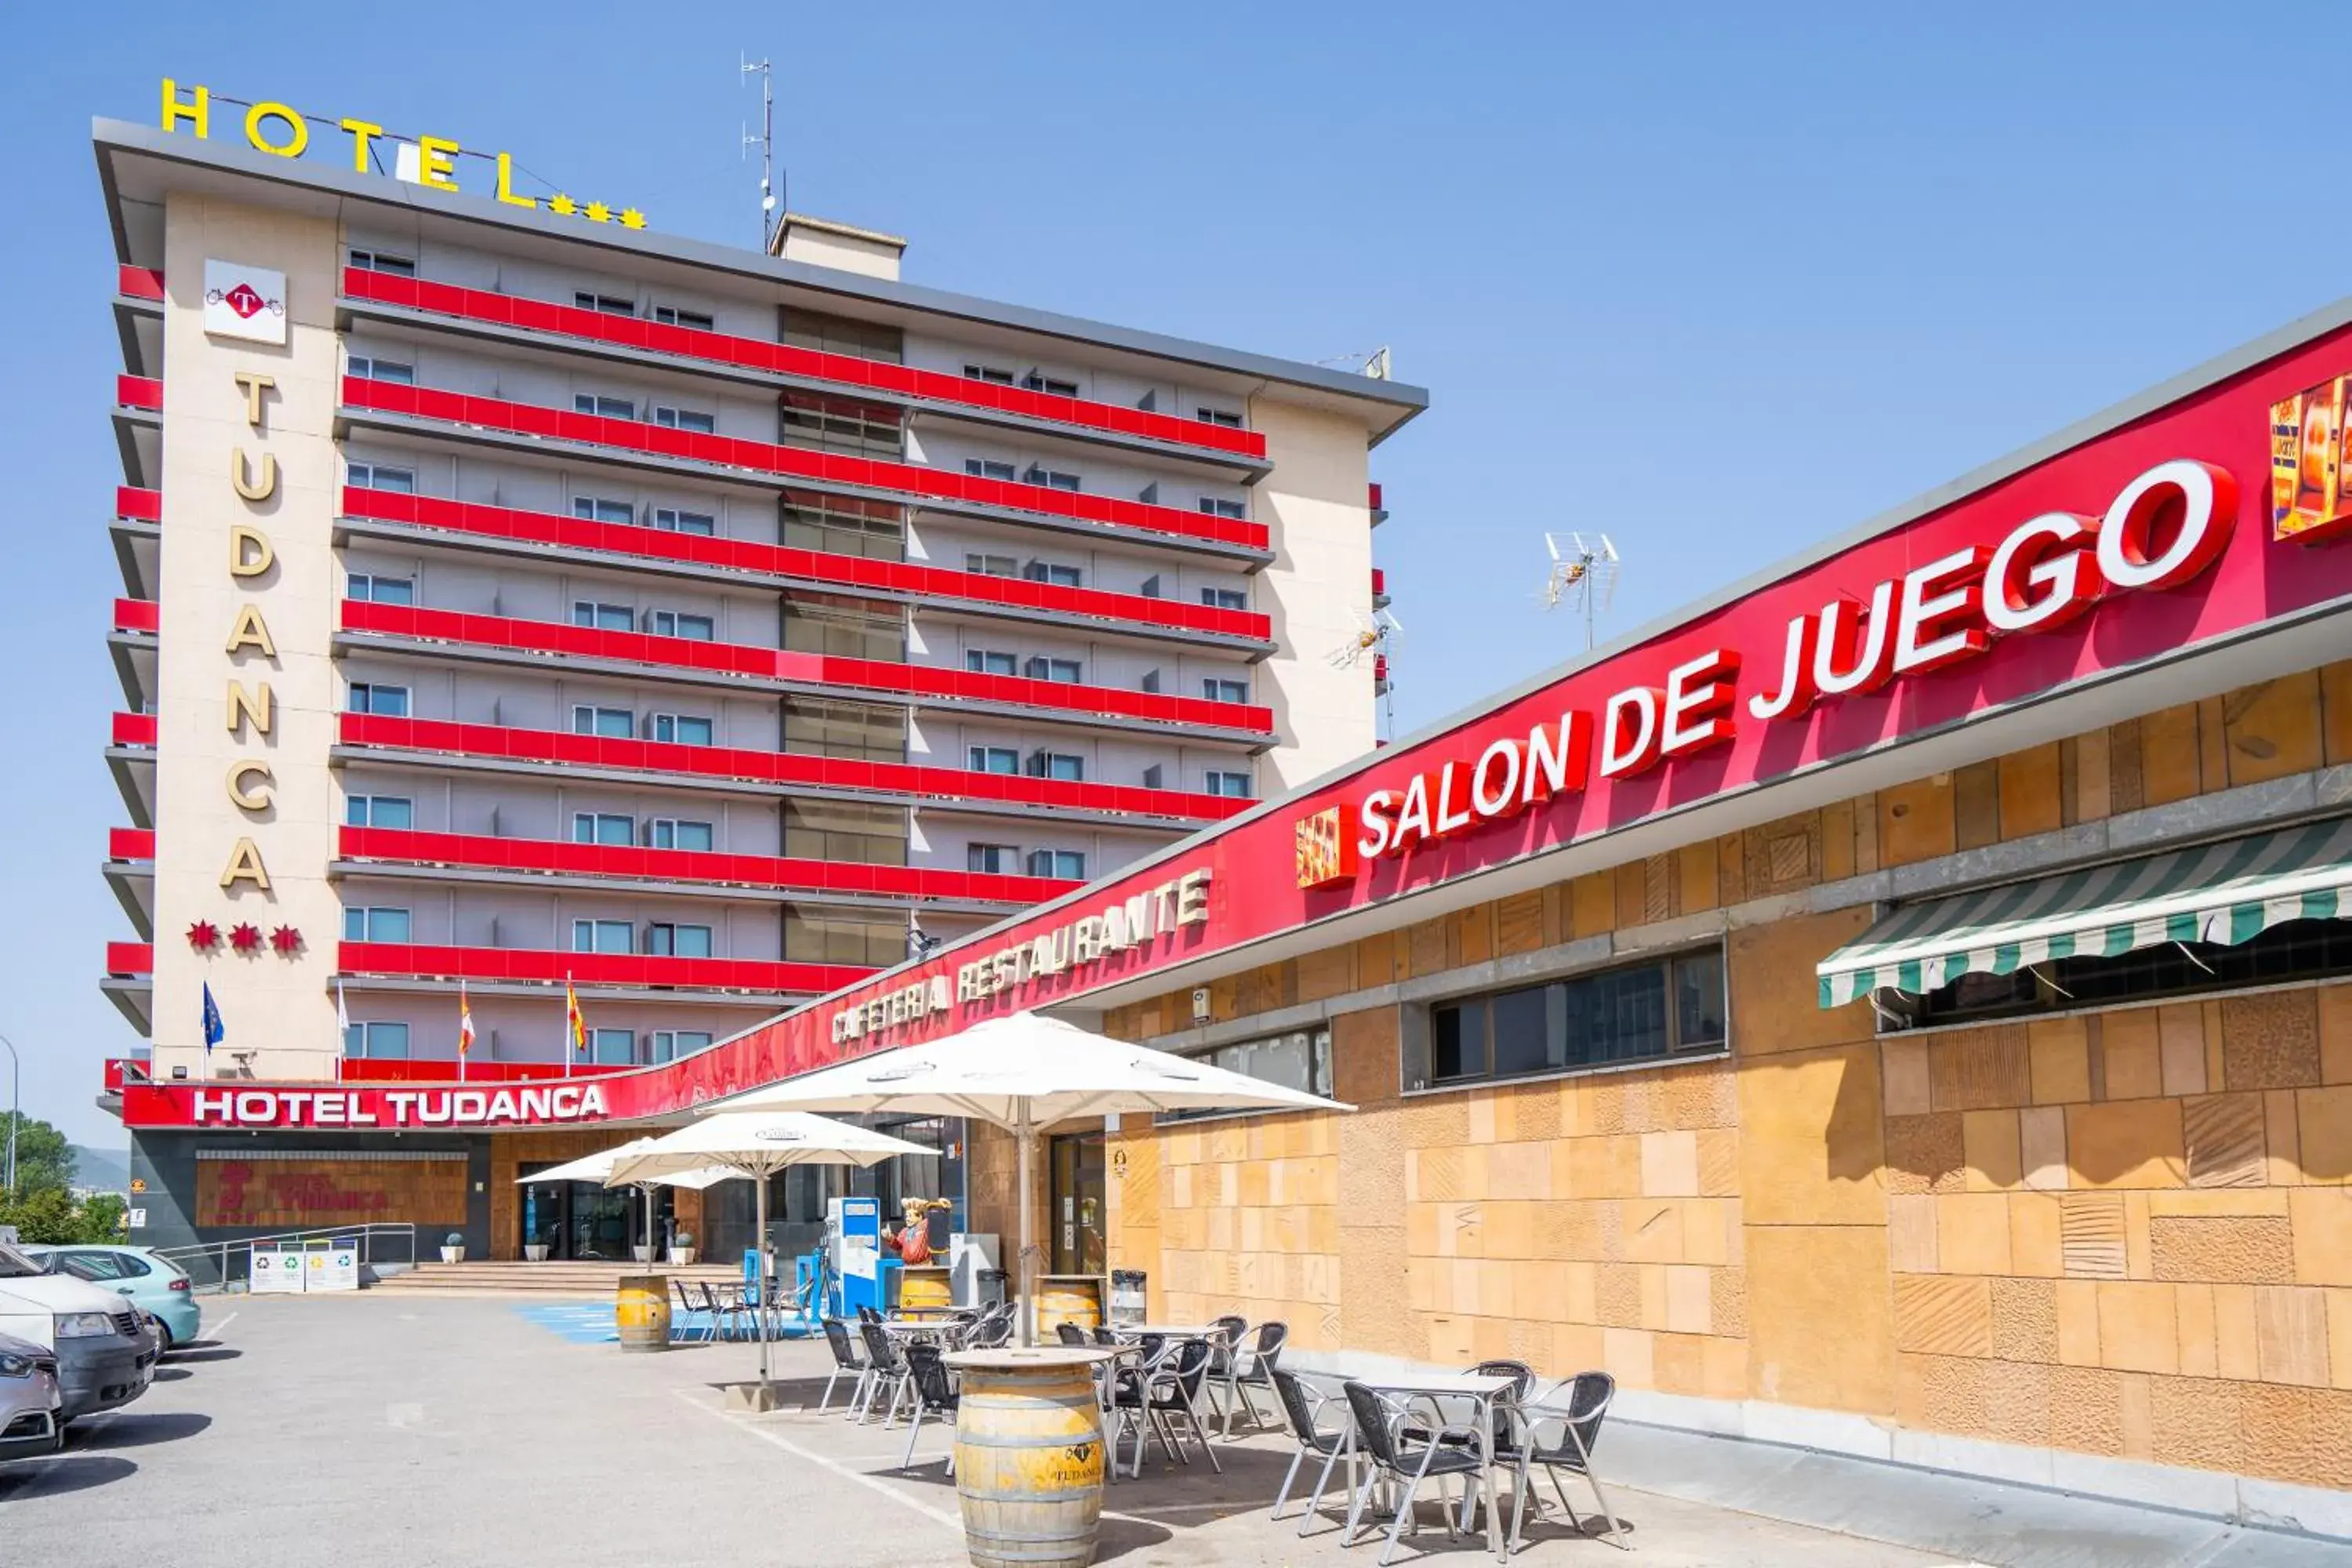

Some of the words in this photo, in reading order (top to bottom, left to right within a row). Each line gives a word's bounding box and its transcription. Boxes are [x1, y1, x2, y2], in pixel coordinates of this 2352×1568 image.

[162, 78, 536, 209] HOTEL
[234, 292, 256, 314] T
[220, 372, 276, 891] TUDANCA
[1358, 710, 1582, 859] SALON
[1600, 649, 1731, 781] DE
[1749, 459, 2227, 720] JUEGO
[831, 975, 953, 1045] CAFETERIA
[957, 867, 1213, 1004] RESTAURANTE
[194, 1091, 378, 1123] HOTEL
[387, 1084, 607, 1123] TUDANCA
